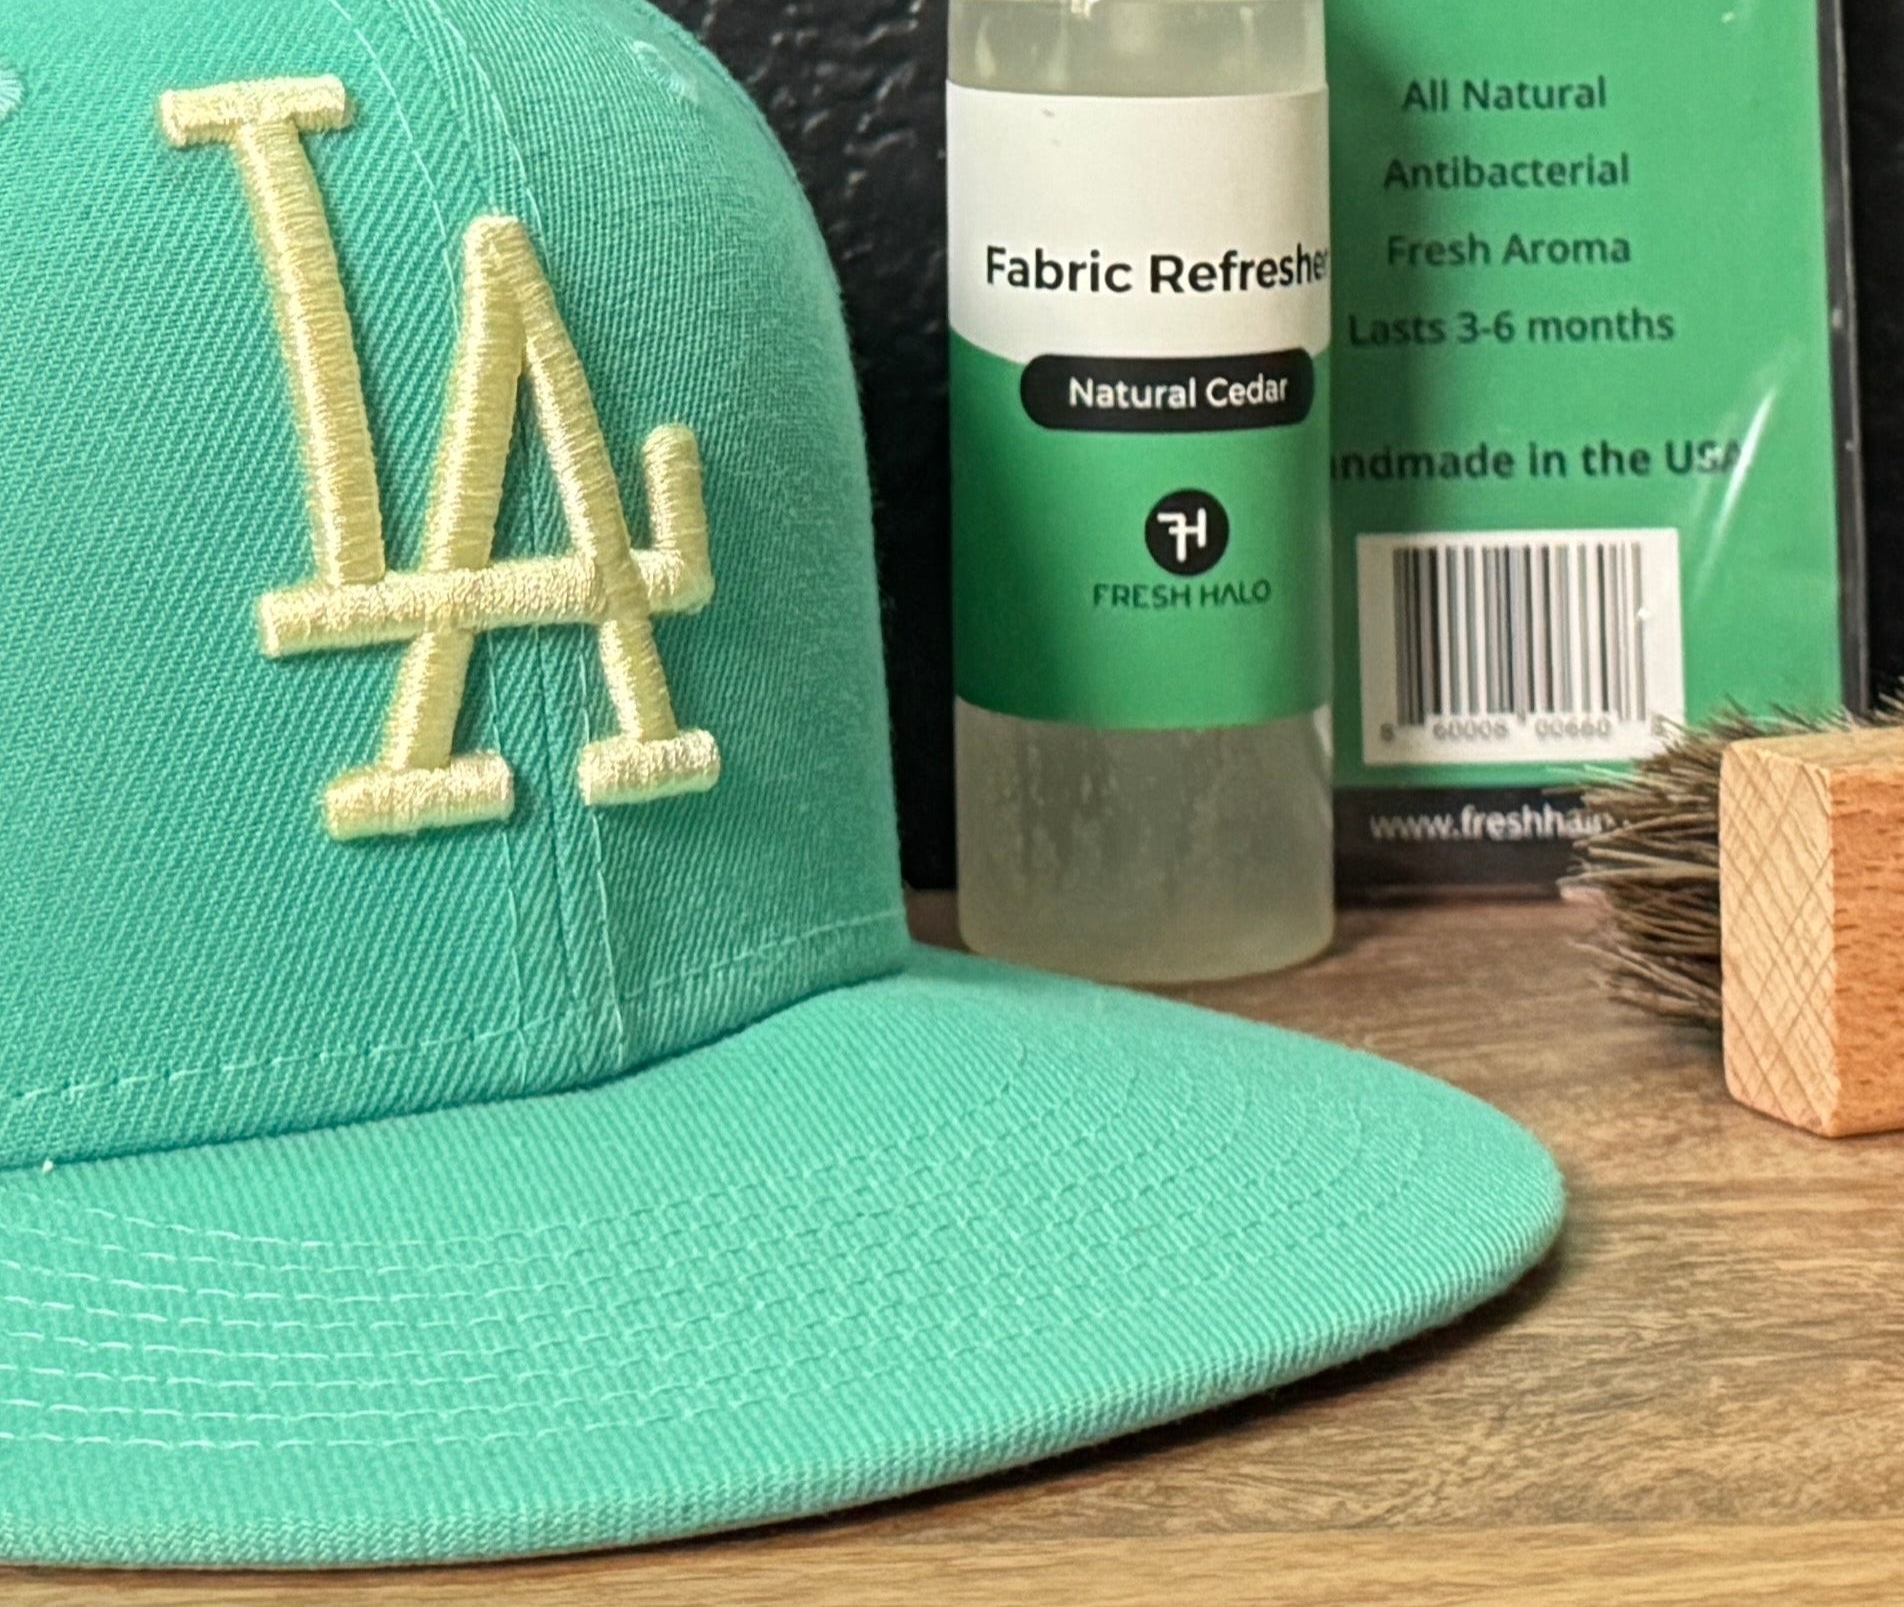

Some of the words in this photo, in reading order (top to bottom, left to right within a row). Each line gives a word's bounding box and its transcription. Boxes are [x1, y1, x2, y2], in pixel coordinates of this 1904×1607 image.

[1402, 79, 1449, 112] All
[1463, 76, 1607, 111] Natural
[1384, 153, 1630, 189] Antibacterial
[1387, 233, 1491, 266] Fresh
[1503, 234, 1631, 265] Aroma
[986, 245, 1132, 293] Fabric
[1348, 312, 1446, 348] Lasts
[1457, 310, 1516, 345] 3-6
[1528, 308, 1675, 344] months
[1069, 377, 1196, 409] Natural
[1205, 373, 1288, 407] Cedar
[159, 75, 720, 841] LA
[1331, 442, 1514, 481] ndmade
[1529, 441, 1567, 477] in
[1582, 440, 1651, 477] the
[1093, 583, 1191, 609] FRESH
[1200, 579, 1271, 607] HALO
